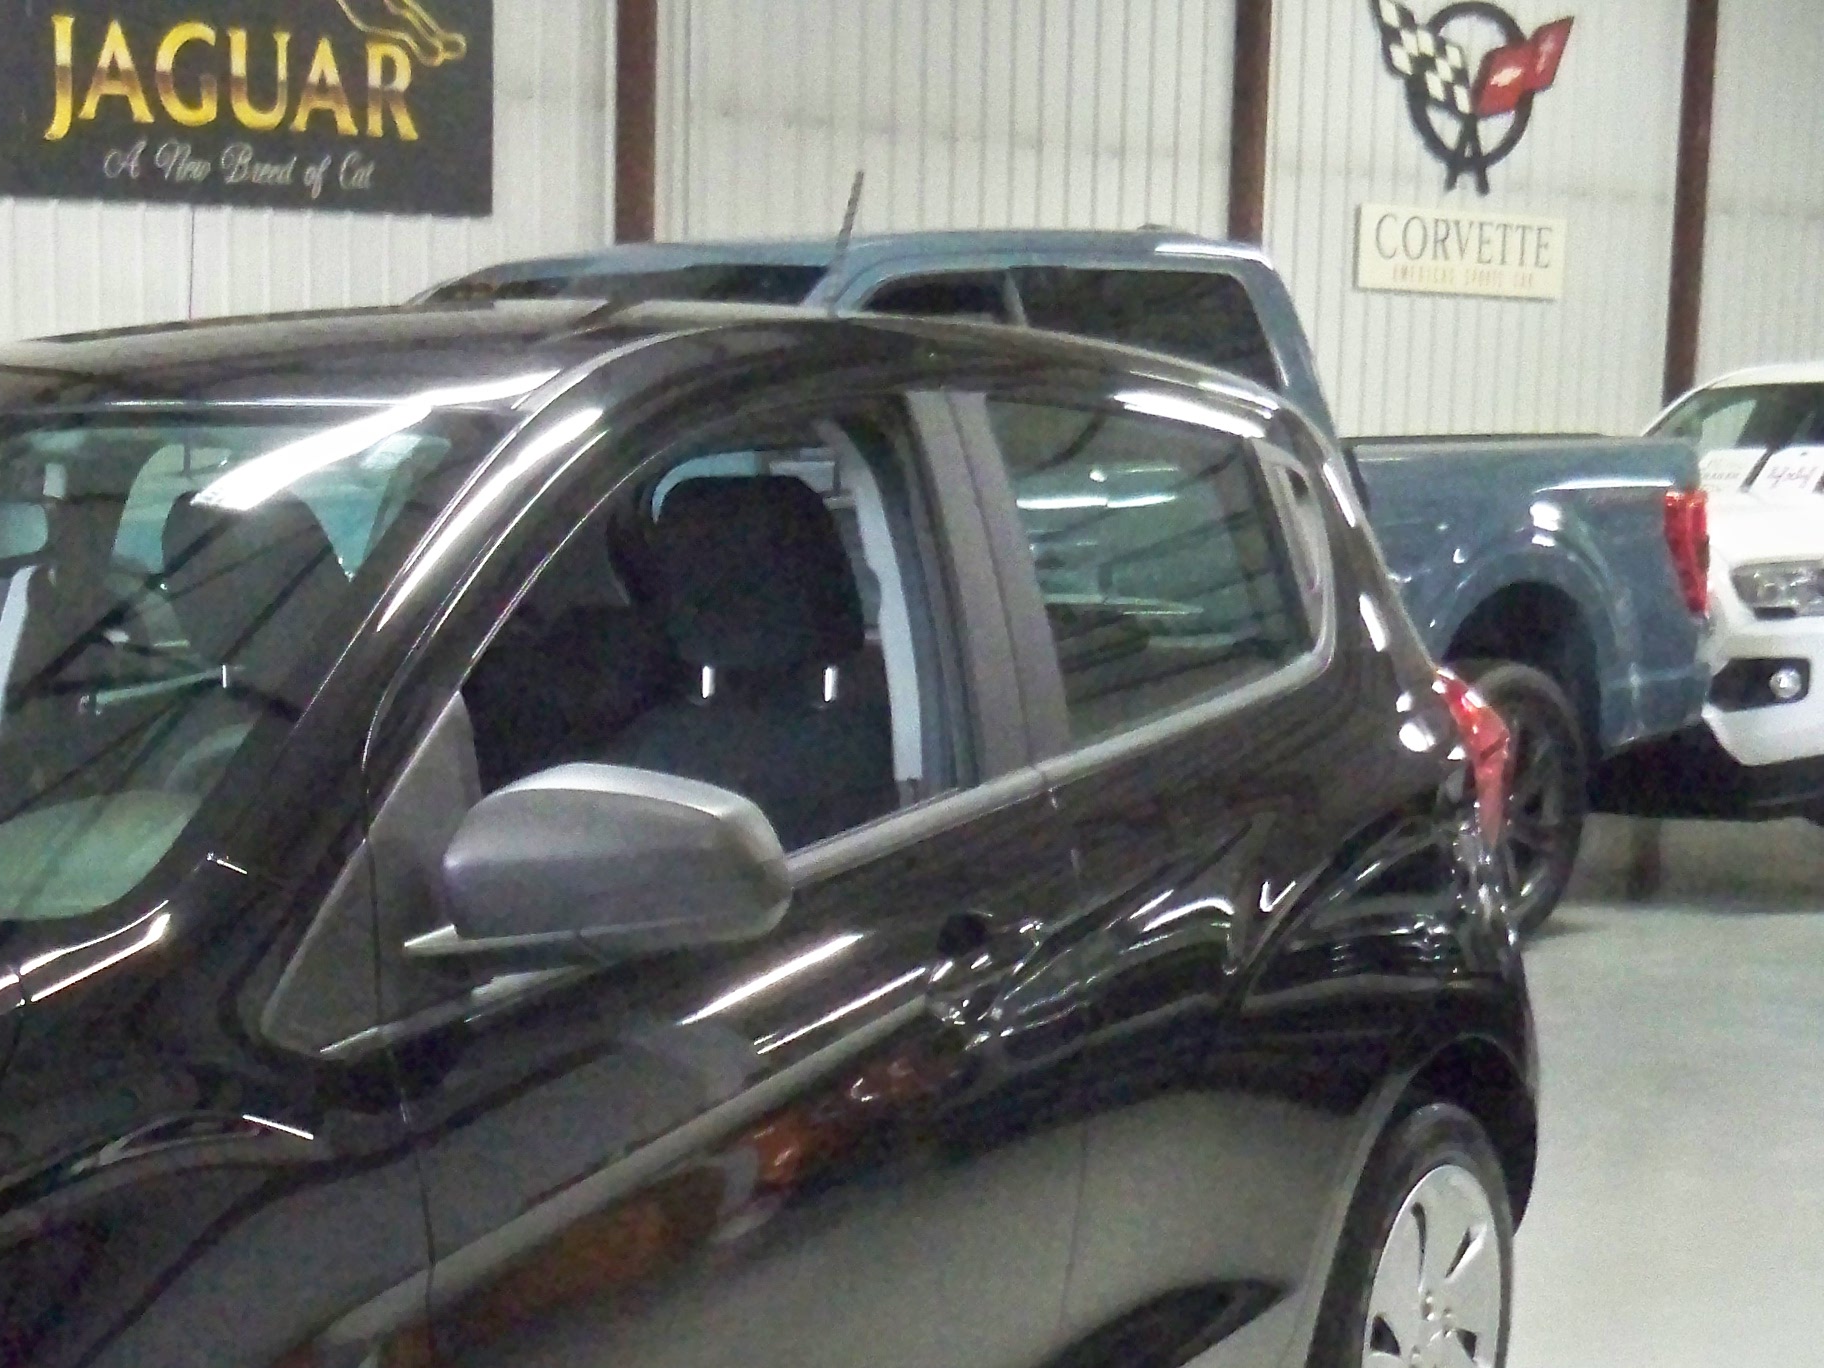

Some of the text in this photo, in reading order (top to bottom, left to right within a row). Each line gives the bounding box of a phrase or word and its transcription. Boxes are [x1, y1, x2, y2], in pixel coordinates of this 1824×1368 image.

[44, 14, 419, 141] JAGUAR
[103, 138, 148, 179] A
[303, 153, 333, 200] of
[1374, 212, 1553, 270] CORVETTE
